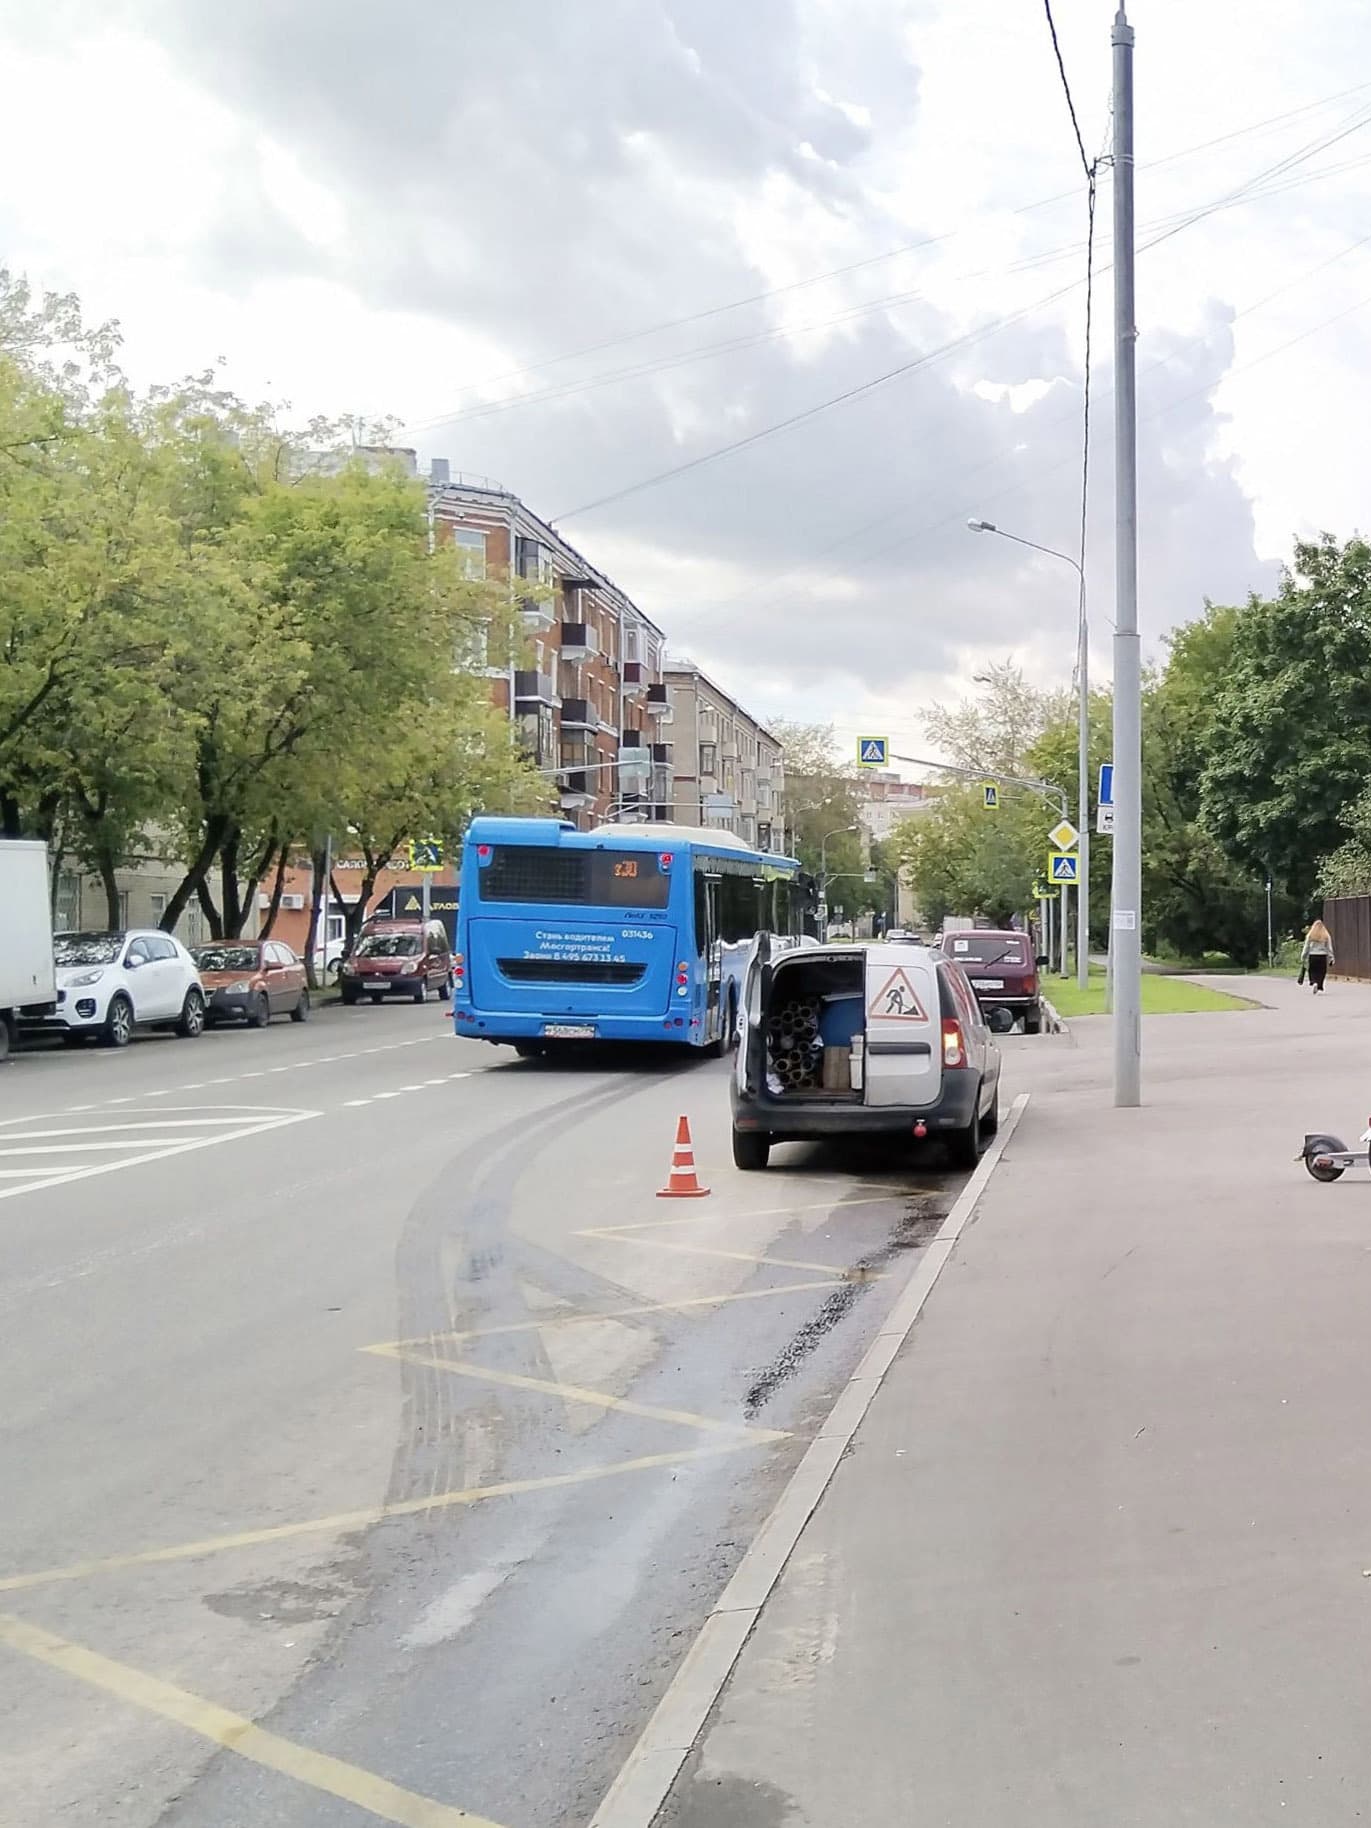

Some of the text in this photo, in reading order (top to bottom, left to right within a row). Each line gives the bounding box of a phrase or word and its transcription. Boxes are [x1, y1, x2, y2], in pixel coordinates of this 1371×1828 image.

[535, 930, 615, 942] Стань водителем
[540, 941, 611, 952] Мосгортранса!
[553, 952, 561, 960] 8
